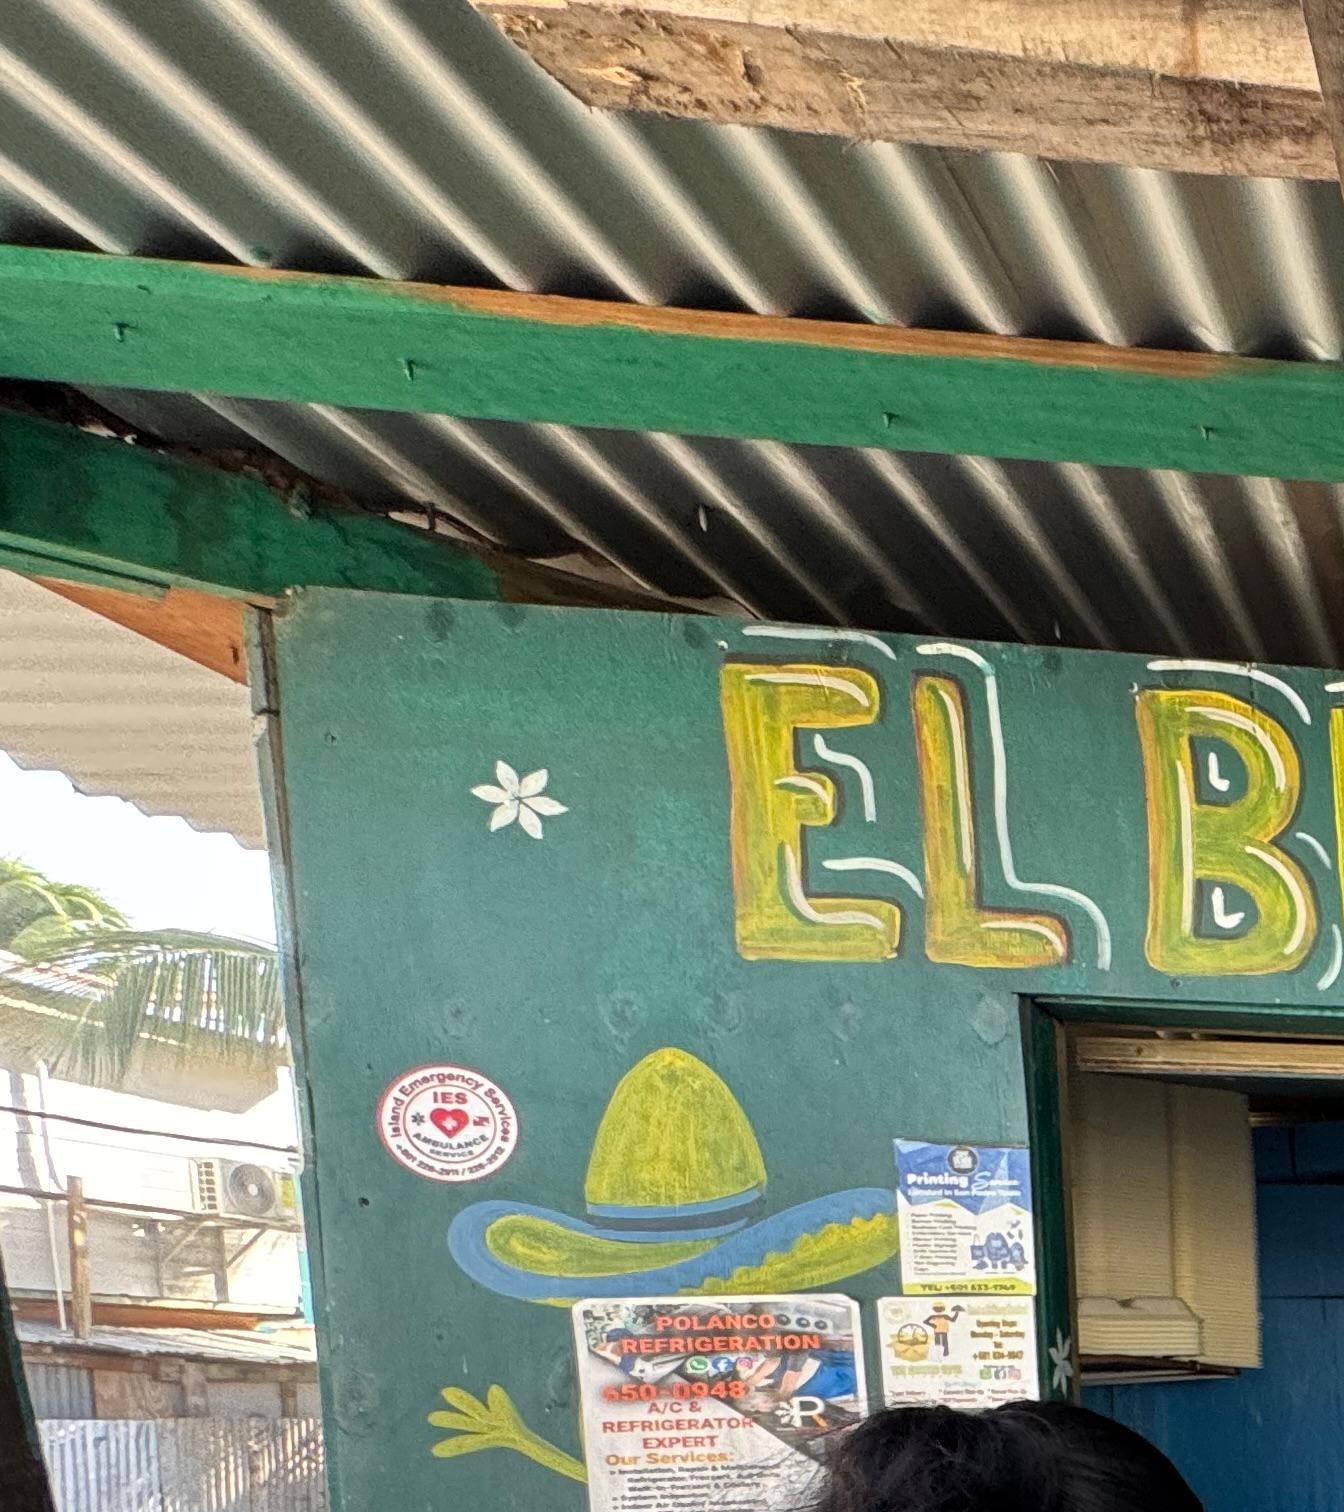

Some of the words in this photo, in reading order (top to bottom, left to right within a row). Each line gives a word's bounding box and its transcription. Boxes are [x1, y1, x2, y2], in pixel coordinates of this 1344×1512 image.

[720, 661, 1071, 970] EL
[433, 1091, 468, 1105] IES
[388, 1097, 405, 1138] Island
[399, 1073, 484, 1097] Emergency
[484, 1088, 512, 1142] Services
[413, 1133, 489, 1150] AMBULANCE
[907, 1172, 969, 1188] Printing
[655, 1313, 777, 1331] POLANCO
[620, 1334, 822, 1353] REFRIGERATION
[603, 1381, 747, 1401] 650-0948
[647, 1402, 683, 1414] A/C
[689, 1401, 701, 1413] &
[602, 1417, 755, 1433] REFRIGERATOR
[642, 1436, 719, 1449] EXPERT
[605, 1455, 640, 1466] Our
[647, 1452, 734, 1465] Services:
